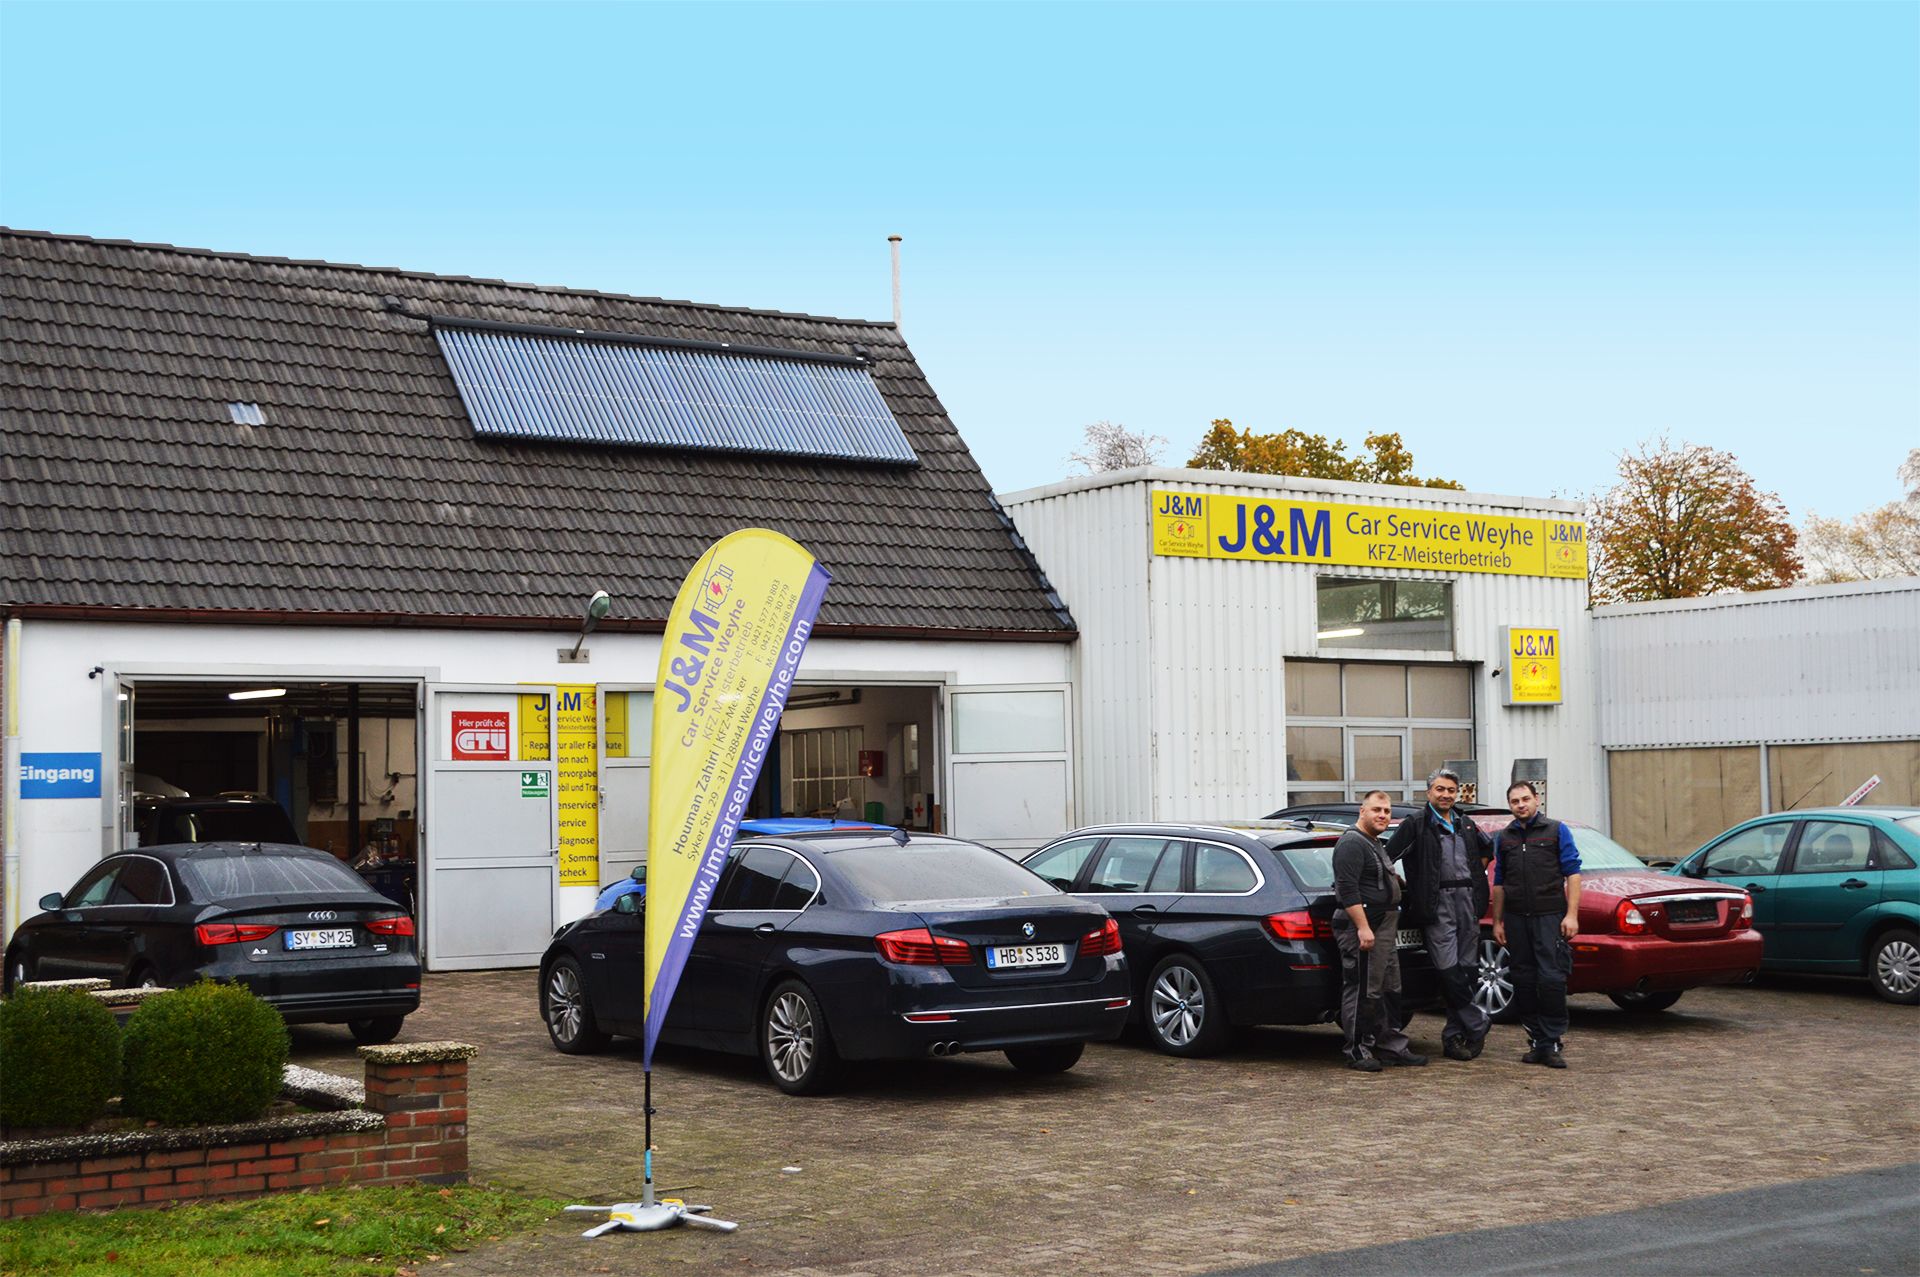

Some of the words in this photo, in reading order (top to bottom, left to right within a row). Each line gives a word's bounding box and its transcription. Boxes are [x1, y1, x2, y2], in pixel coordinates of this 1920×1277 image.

[1159, 495, 1202, 516] J&M
[1218, 504, 1331, 557] J&M
[1346, 511, 1381, 535] Car
[1388, 514, 1460, 541] Service
[1466, 520, 1533, 550] Weyhe
[1550, 524, 1583, 542] J&M
[1368, 543, 1512, 568] KFZ-Meisterbetrieb
[769, 579, 781, 595] 803
[765, 595, 774, 608] 30
[758, 607, 769, 625] 577
[760, 630, 772, 651] 0421
[779, 584, 790, 601] 779
[751, 625, 763, 647] 0421
[1514, 635, 1555, 656] J&M
[664, 608, 721, 714] J&M
[681, 718, 699, 748] Car
[693, 657, 724, 717] Service
[716, 598, 746, 654] Weyhe
[534, 692, 581, 711] JM
[459, 719, 473, 727] Hier
[475, 718, 493, 729] prüft
[494, 719, 506, 727] die
[702, 715, 719, 741] KFZ
[569, 740, 586, 749] aller
[571, 755, 589, 763] nach
[20, 765, 94, 783] Eingang
[680, 619, 811, 939] www.jmcarserviceweyhe.com
[687, 830, 706, 862] Syker
[700, 809, 713, 829] Str.
[707, 791, 720, 808] 29
[718, 769, 730, 784] 31
[726, 727, 745, 762] 28844
[738, 686, 761, 725] Weyhe
[671, 793, 703, 855] Houman
[695, 749, 720, 793] Zahiri
[294, 932, 310, 945] SY
[319, 931, 335, 944] SM
[337, 930, 353, 943] 25
[1000, 949, 1018, 964] HB
[1025, 947, 1034, 962] S
[1035, 946, 1060, 962] 538
